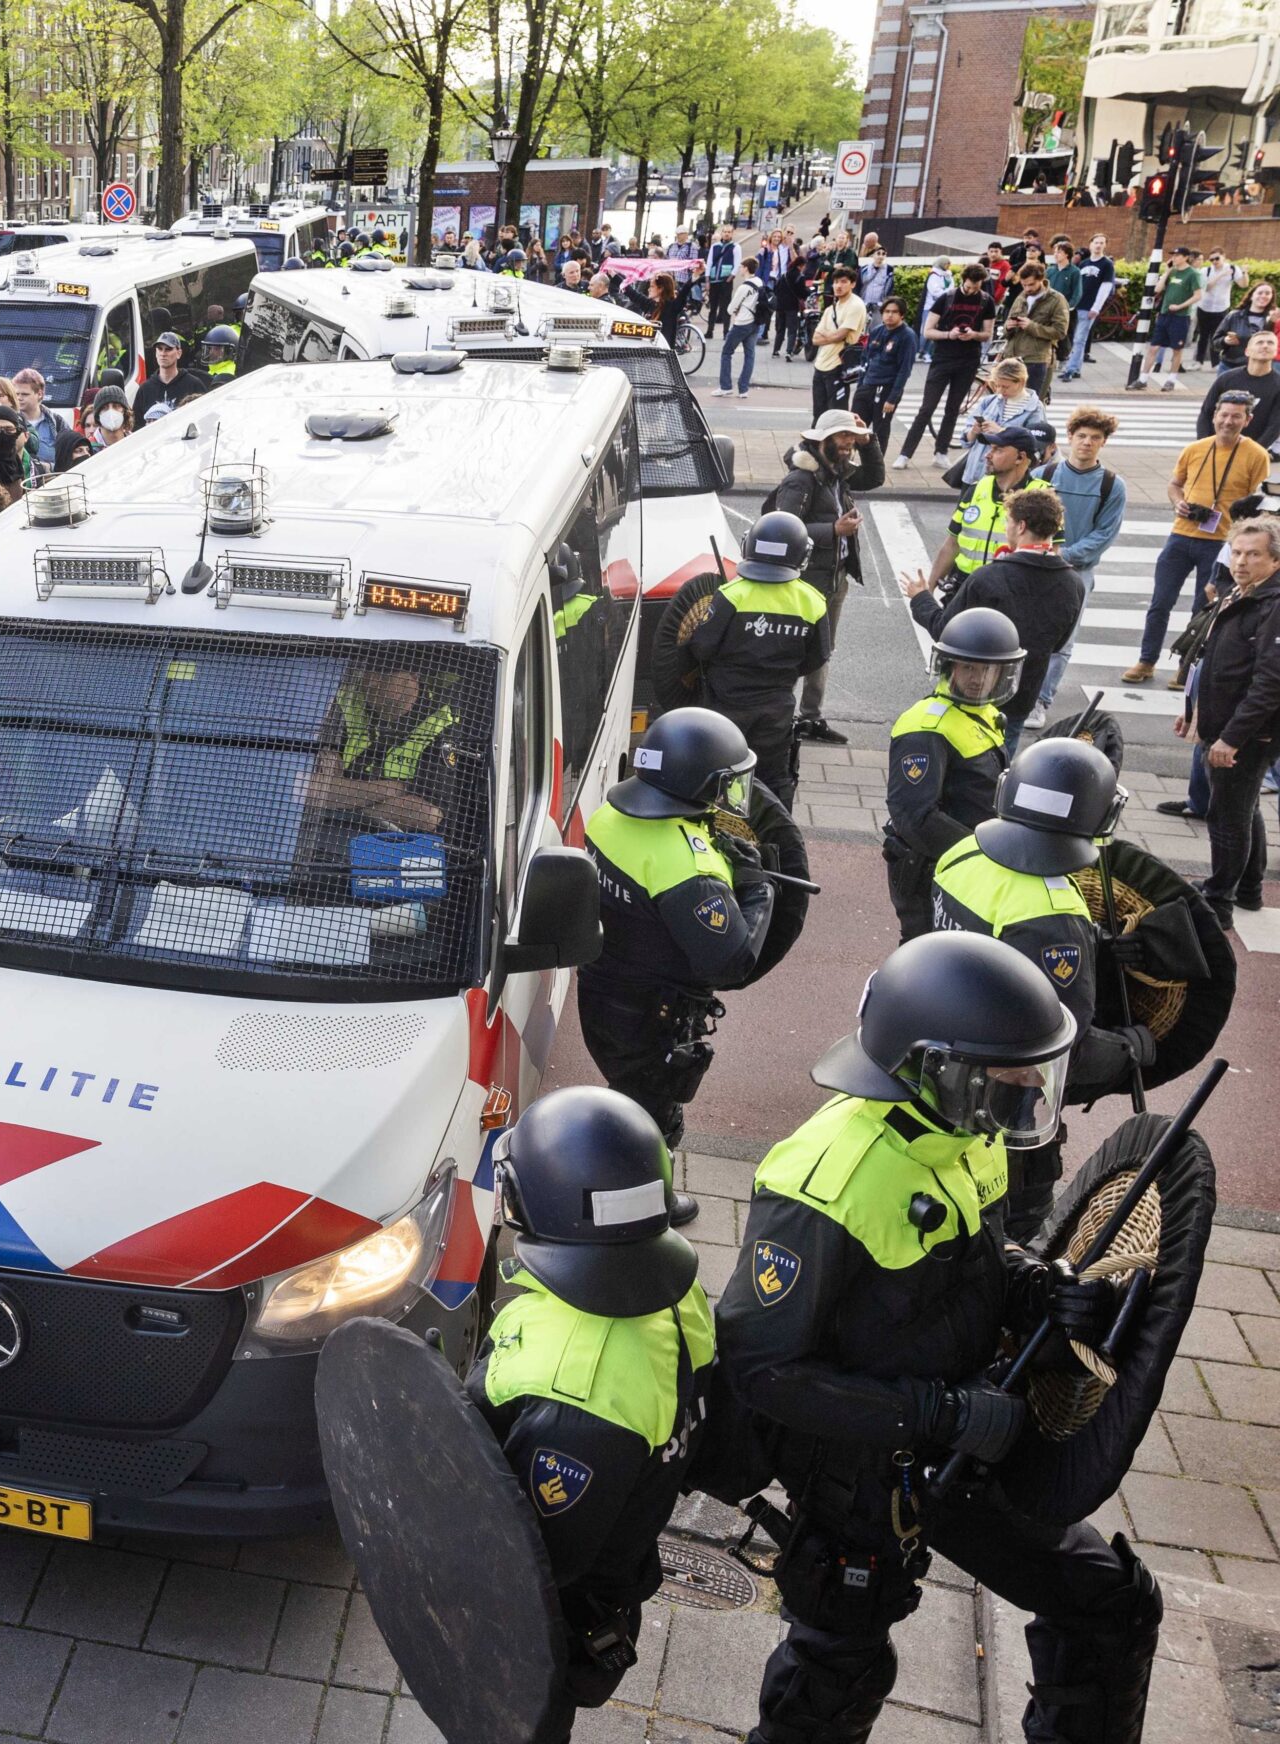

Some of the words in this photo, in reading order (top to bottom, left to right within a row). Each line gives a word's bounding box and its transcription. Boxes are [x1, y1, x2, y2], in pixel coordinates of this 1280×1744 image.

[744, 615, 809, 637] POLITIE
[640, 751, 648, 765] C
[903, 757, 927, 766] POLITIE
[692, 837, 708, 852] C
[697, 899, 722, 915] POLITIE
[1045, 950, 1078, 960] POLITIE
[757, 1246, 796, 1269] POLITIE
[539, 1455, 587, 1481] POLITIE
[848, 1572, 866, 1584] TQ
